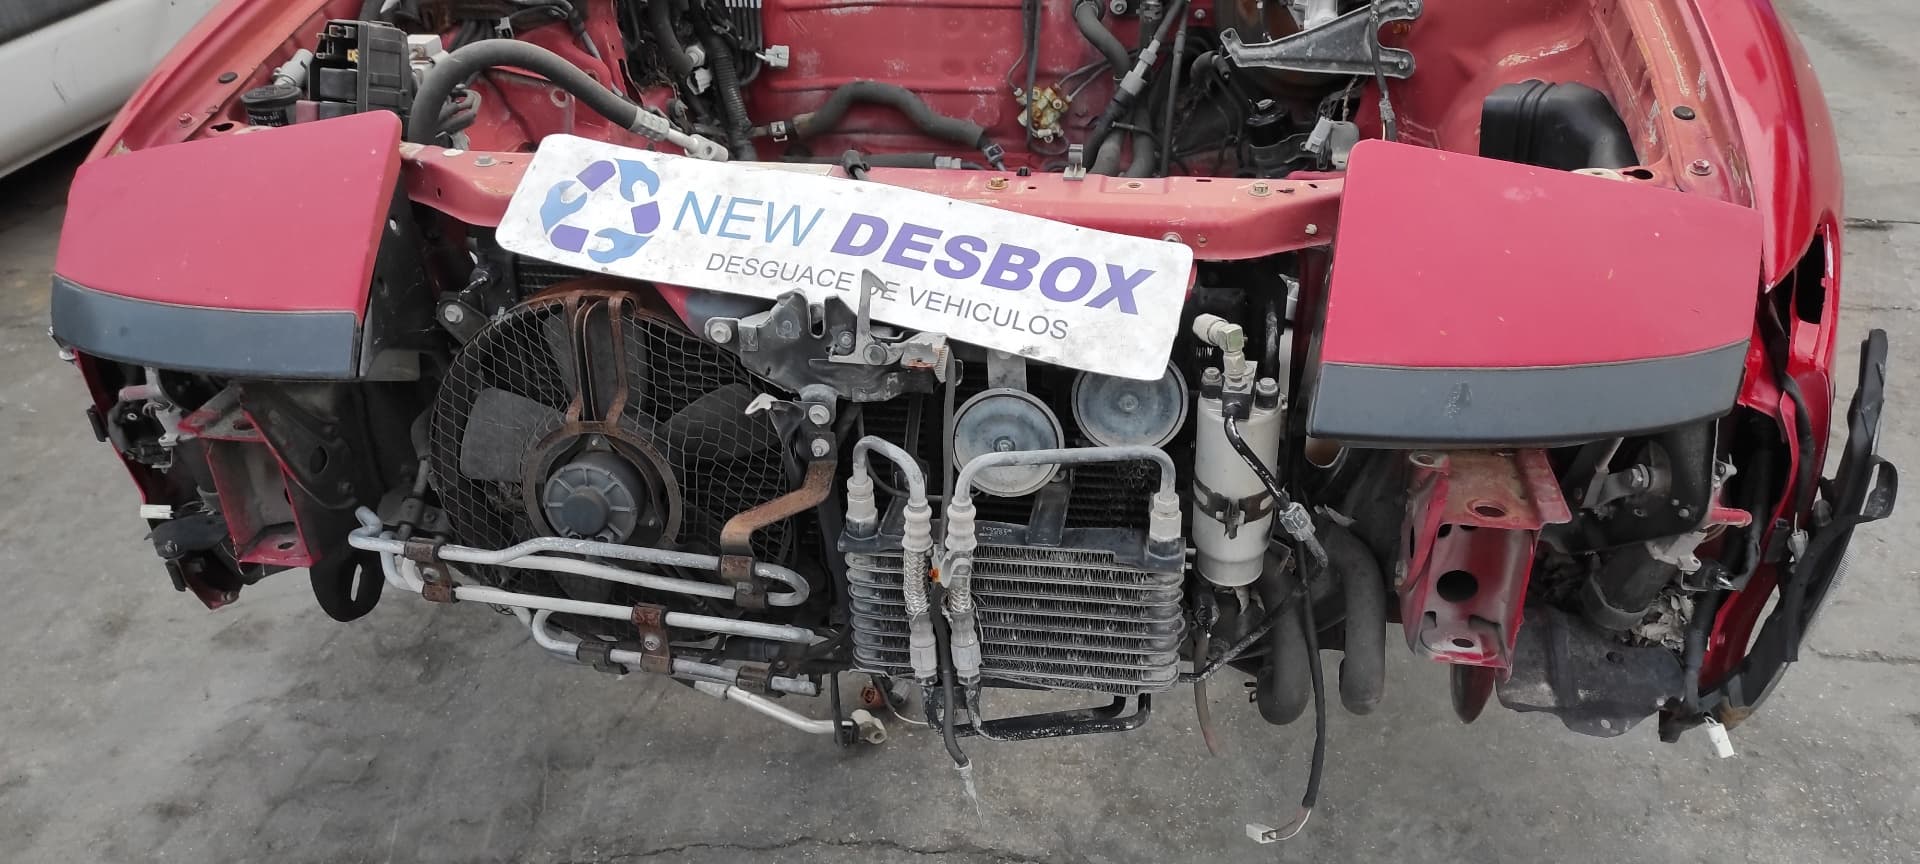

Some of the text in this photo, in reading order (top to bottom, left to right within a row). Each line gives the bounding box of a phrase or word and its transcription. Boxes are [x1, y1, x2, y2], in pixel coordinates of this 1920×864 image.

[672, 191, 1156, 315] NEW DESBOX
[706, 253, 855, 291] DESGUACE
[909, 286, 1069, 340] VEHICULOS
